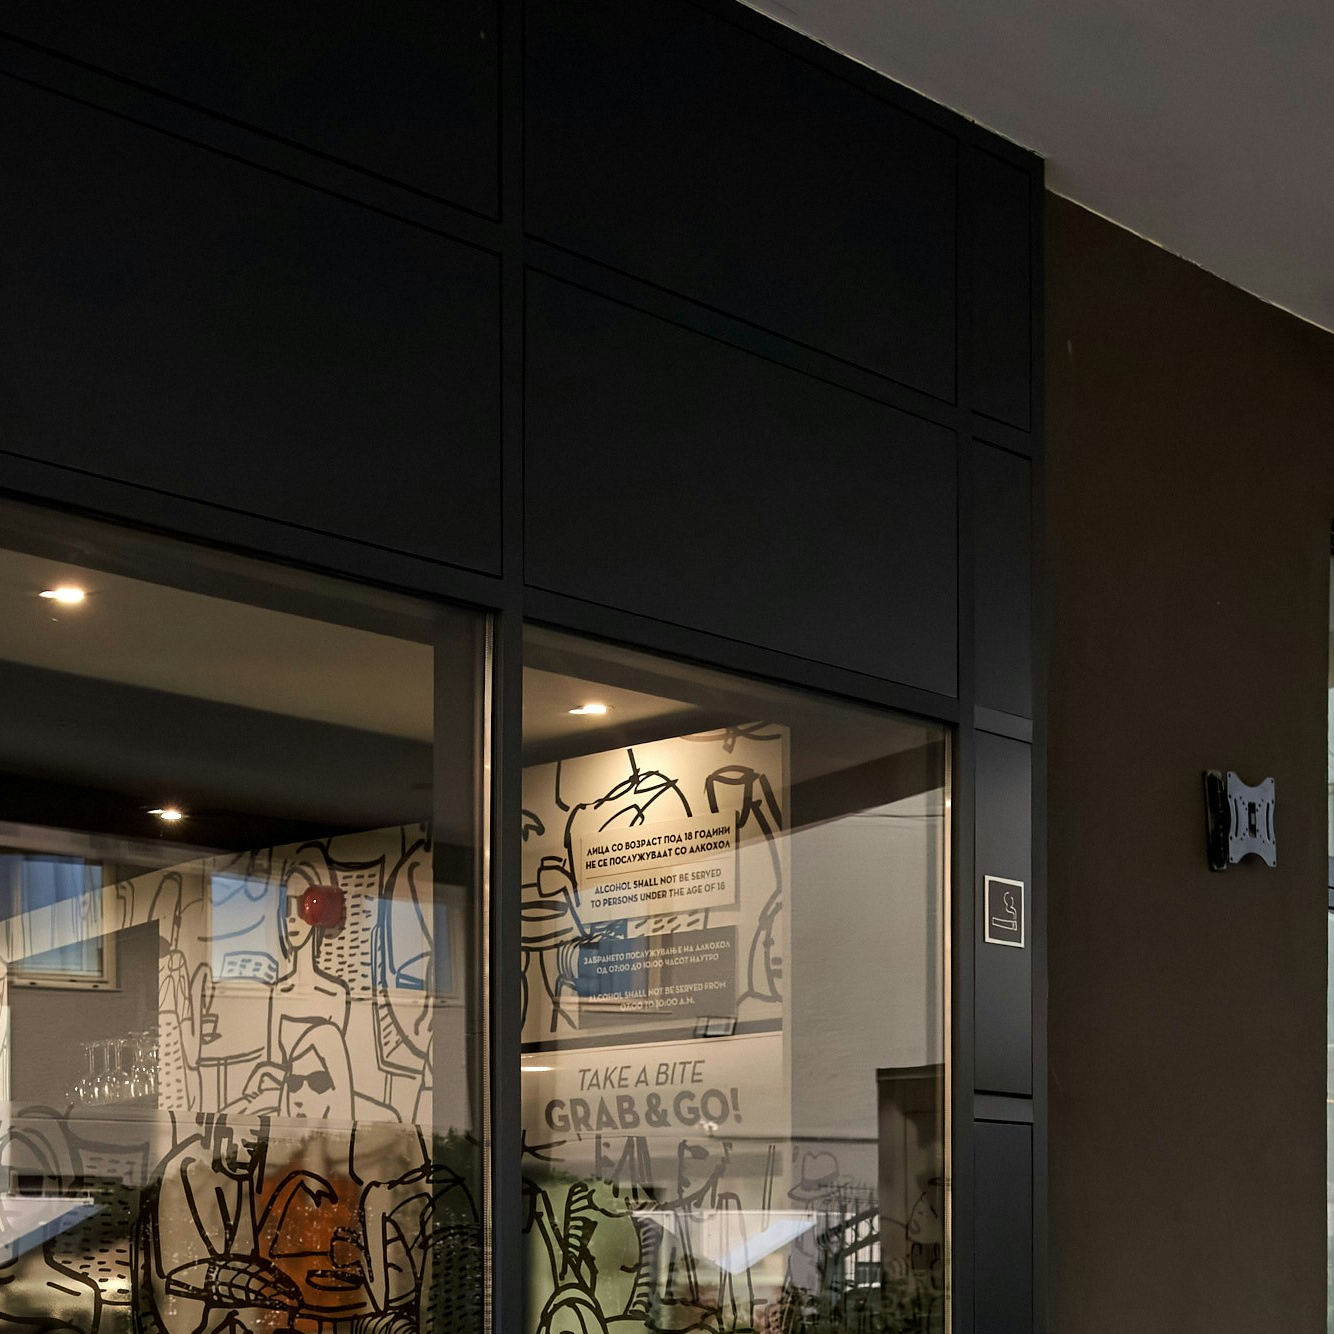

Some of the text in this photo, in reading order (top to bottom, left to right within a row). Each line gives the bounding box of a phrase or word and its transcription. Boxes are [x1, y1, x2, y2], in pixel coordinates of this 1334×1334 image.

[585, 840, 731, 869] НЕ СЕ ПОСЛУЖУВААТ СО АЛКОХОЛ
[587, 826, 731, 856] ЛИЦА СО ВОЗРАСТ ПОД 18 ГОДИНИ
[591, 882, 725, 908] TO PERSONS UNDER THE AGE OF 18
[595, 869, 722, 894] ALCOHOL SHALL NOT BE SERVED
[625, 989, 646, 998] SHALL
[649, 987, 663, 996] NOT
[676, 983, 703, 993] SERVED
[579, 1060, 705, 1091] TAKE A BITE
